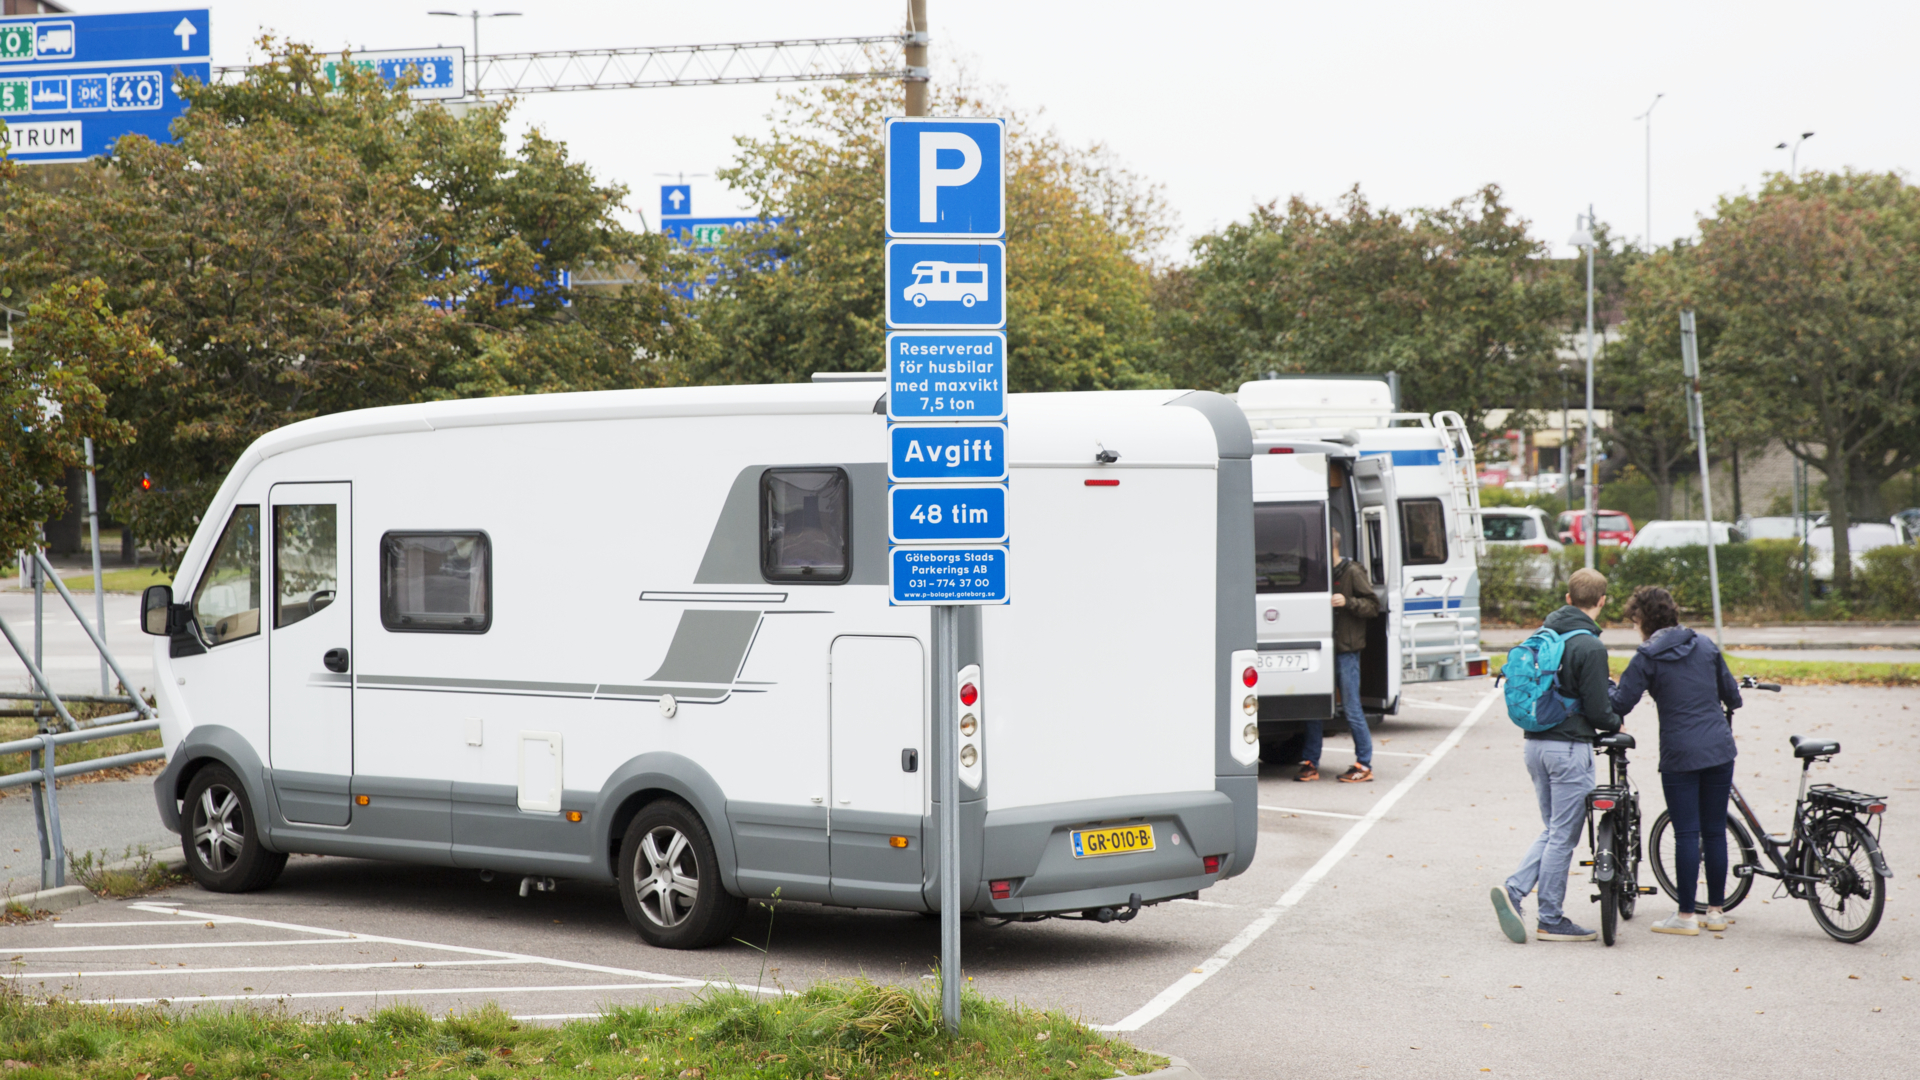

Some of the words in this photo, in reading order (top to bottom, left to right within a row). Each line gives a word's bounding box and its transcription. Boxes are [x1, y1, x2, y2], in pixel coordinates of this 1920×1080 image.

[393, 62, 437, 84] 18
[81, 87, 99, 100] DK
[119, 81, 153, 102] 40
[920, 132, 982, 223] P
[701, 229, 722, 244] E6
[900, 342, 992, 355] Reserverad
[900, 361, 923, 373] för
[929, 360, 993, 373] husbilar
[896, 379, 928, 391] med
[935, 379, 998, 391] maxvikt
[920, 397, 944, 412] 7,5
[950, 398, 974, 411] ton
[905, 439, 992, 467] Avgift
[910, 504, 942, 524] 48
[952, 504, 987, 523] tim
[906, 552, 960, 564] Göteborgs
[964, 552, 994, 562] Stads
[912, 566, 970, 576] Parkerings
[972, 564, 988, 574] AB
[960, 578, 972, 588] 37
[974, 578, 990, 588] 00
[1277, 655, 1302, 668] 797
[1087, 829, 1149, 852] GR-010-B
